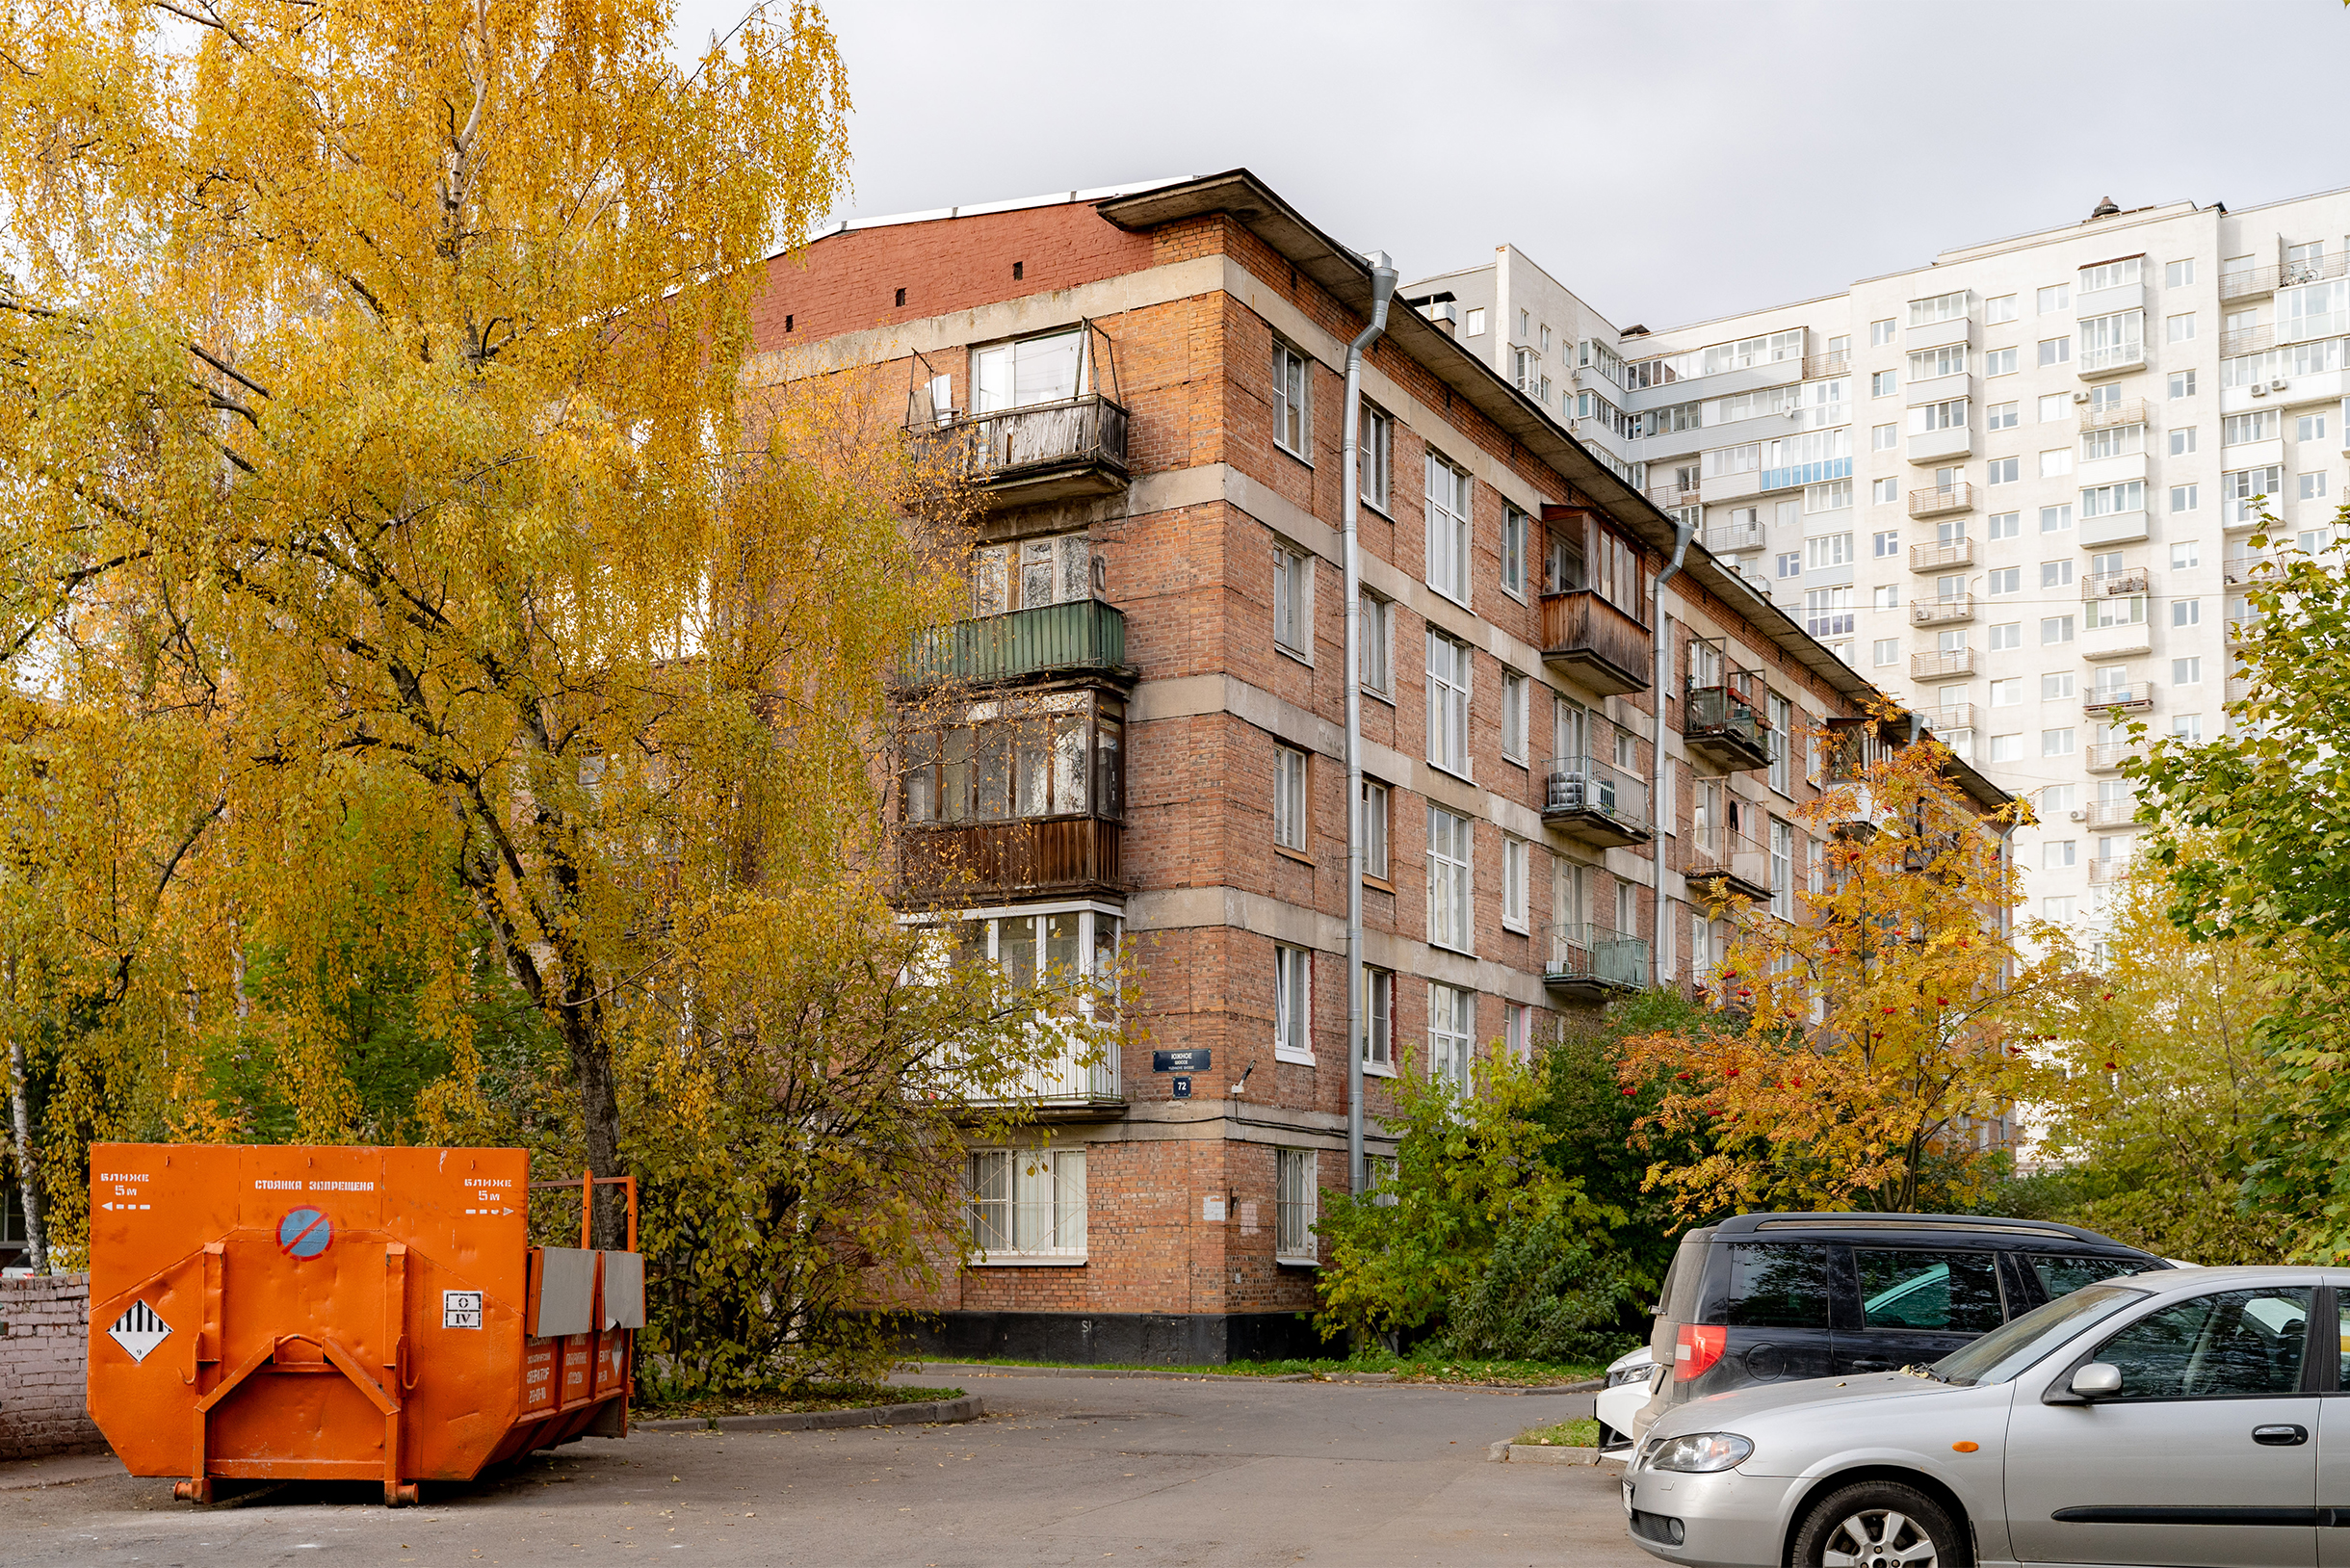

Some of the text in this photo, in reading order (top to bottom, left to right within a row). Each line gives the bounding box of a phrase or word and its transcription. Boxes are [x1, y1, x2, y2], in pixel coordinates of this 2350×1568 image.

[1177, 1082, 1187, 1090] 72
[100, 1173, 149, 1182] БЛИЖЕ
[254, 1180, 375, 1191] СТОЯНКА ЗАПРЕЩЕНА
[464, 1178, 512, 1188] БЛИЖЕ
[455, 1313, 471, 1324] IV
